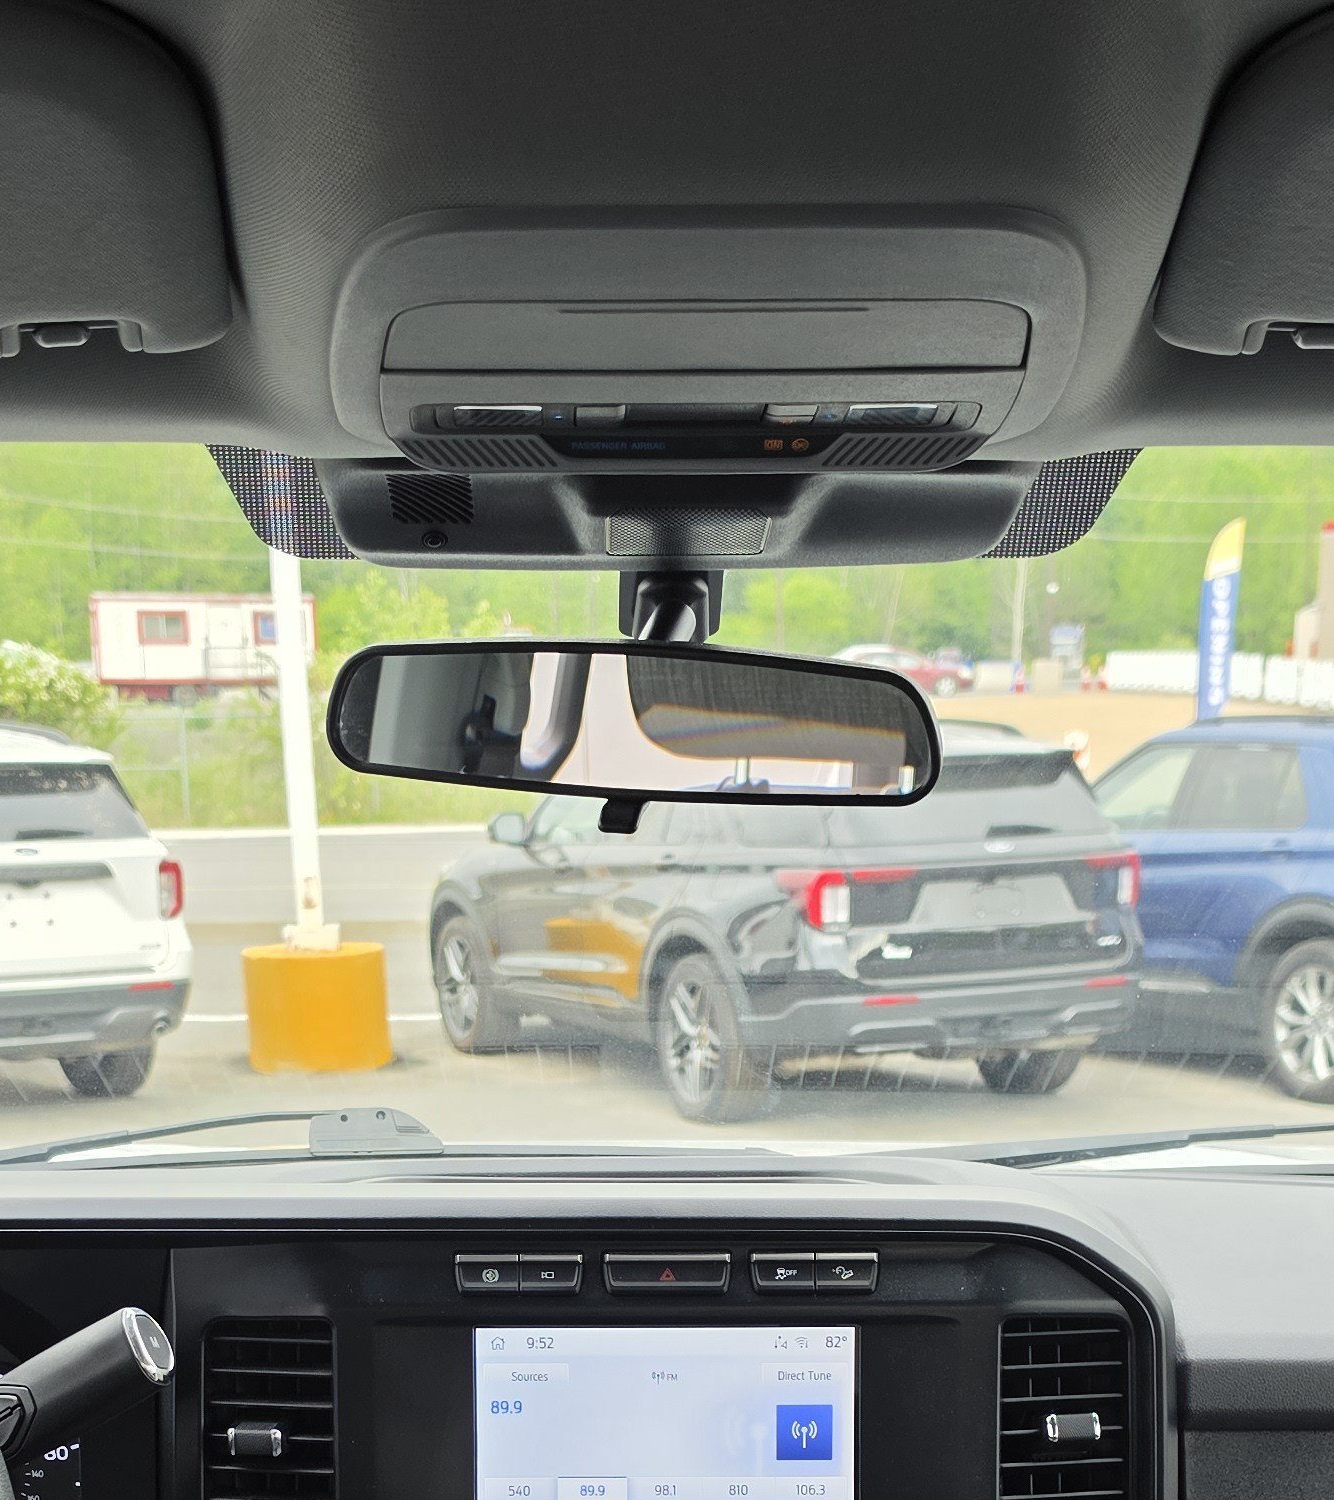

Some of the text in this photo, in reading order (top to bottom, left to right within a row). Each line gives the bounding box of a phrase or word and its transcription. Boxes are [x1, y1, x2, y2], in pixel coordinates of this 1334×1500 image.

[526, 1336, 555, 1350] 9:52
[825, 1335, 848, 1349] 82°
[511, 1371, 549, 1382] Sources
[666, 1372, 678, 1381] FM
[777, 1370, 832, 1381] Direct Tune
[490, 1400, 523, 1414] 89.9
[31, 1470, 44, 1478] 140
[508, 1484, 531, 1497] 540
[579, 1484, 606, 1497] 89.9
[654, 1484, 677, 1497] 98.1
[728, 1484, 749, 1496] 810
[796, 1484, 826, 1496] 106.3
